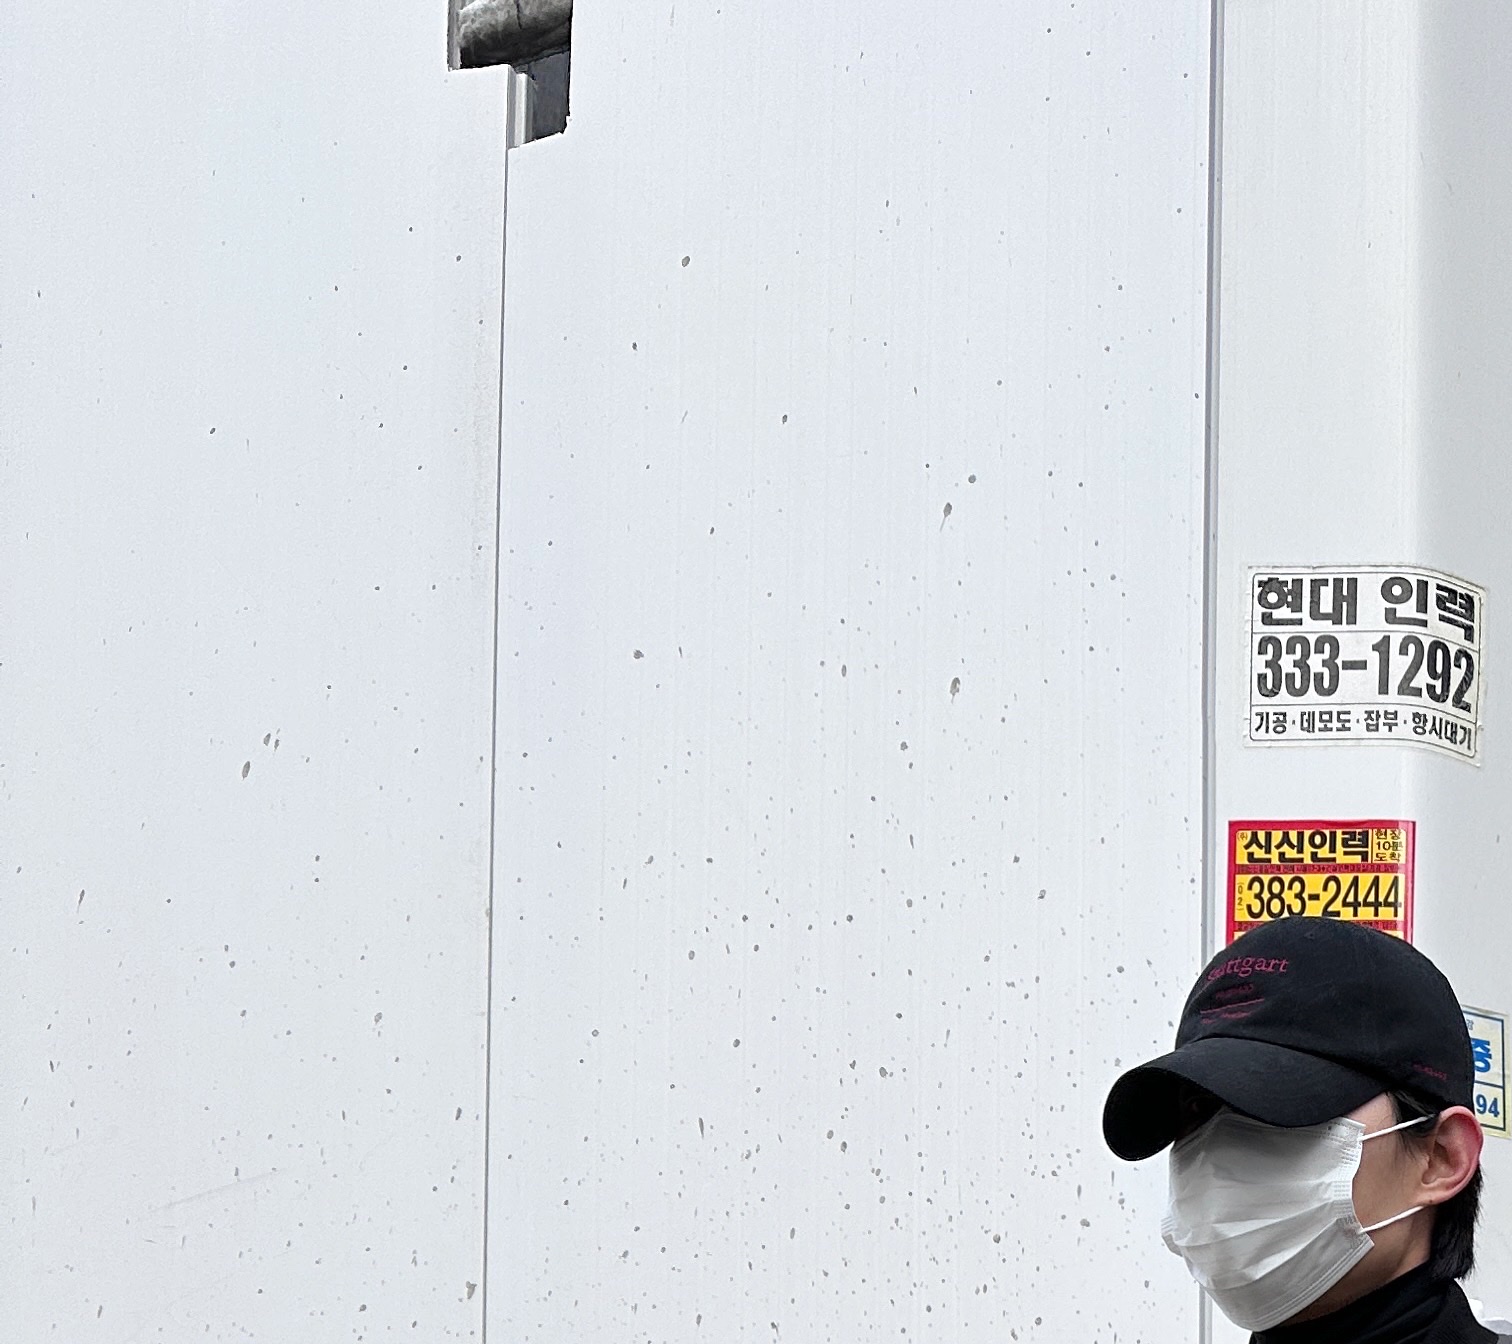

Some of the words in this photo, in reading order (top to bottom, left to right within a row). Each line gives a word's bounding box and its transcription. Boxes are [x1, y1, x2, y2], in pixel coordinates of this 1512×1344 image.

[1257, 577, 1359, 627] 현대
[1380, 576, 1475, 644] 인력
[1257, 634, 1475, 713] 333-1292
[1255, 711, 1288, 735] 기공
[1299, 710, 1352, 733] 데모도
[1363, 709, 1400, 733] 잡부
[1411, 710, 1474, 752] 항시대기
[1243, 829, 1370, 864] 신신인력
[1246, 875, 1402, 920] 383-2444
